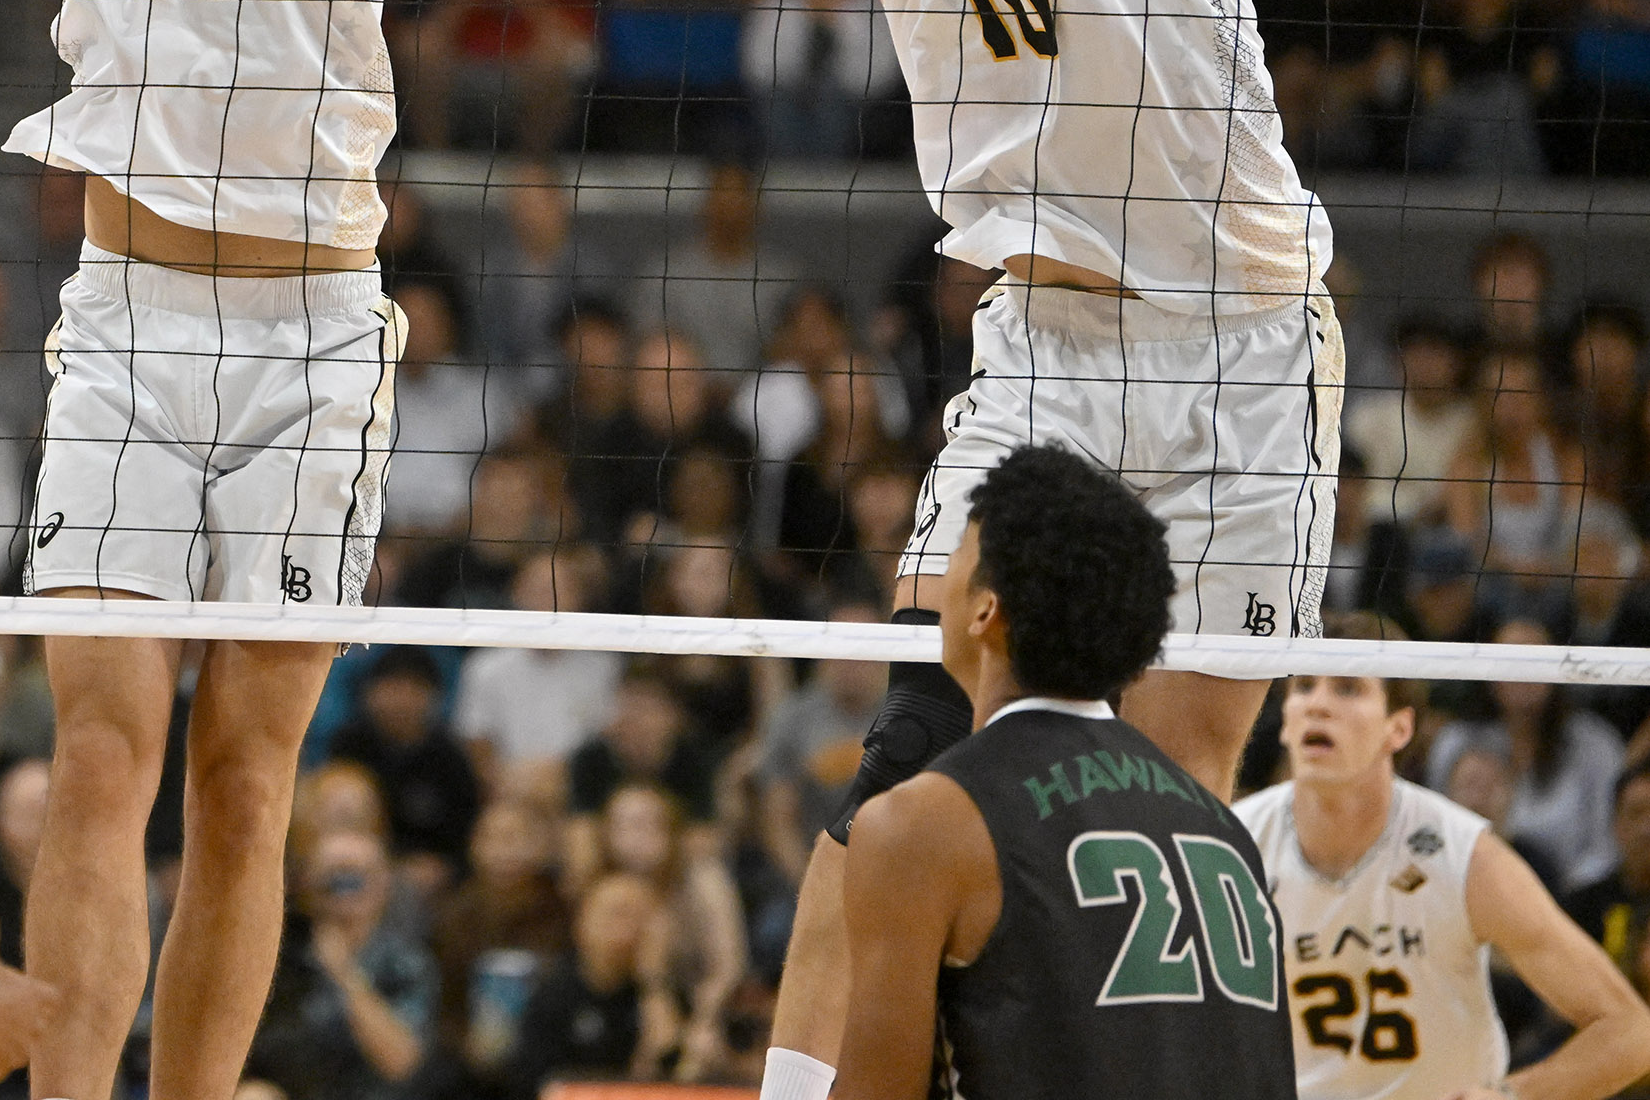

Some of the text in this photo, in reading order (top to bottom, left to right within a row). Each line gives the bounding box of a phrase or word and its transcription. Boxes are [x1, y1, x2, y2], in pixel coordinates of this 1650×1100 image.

[1241, 591, 1277, 637] LB
[1066, 830, 1280, 1013] 20
[1293, 964, 1419, 1063] 26
